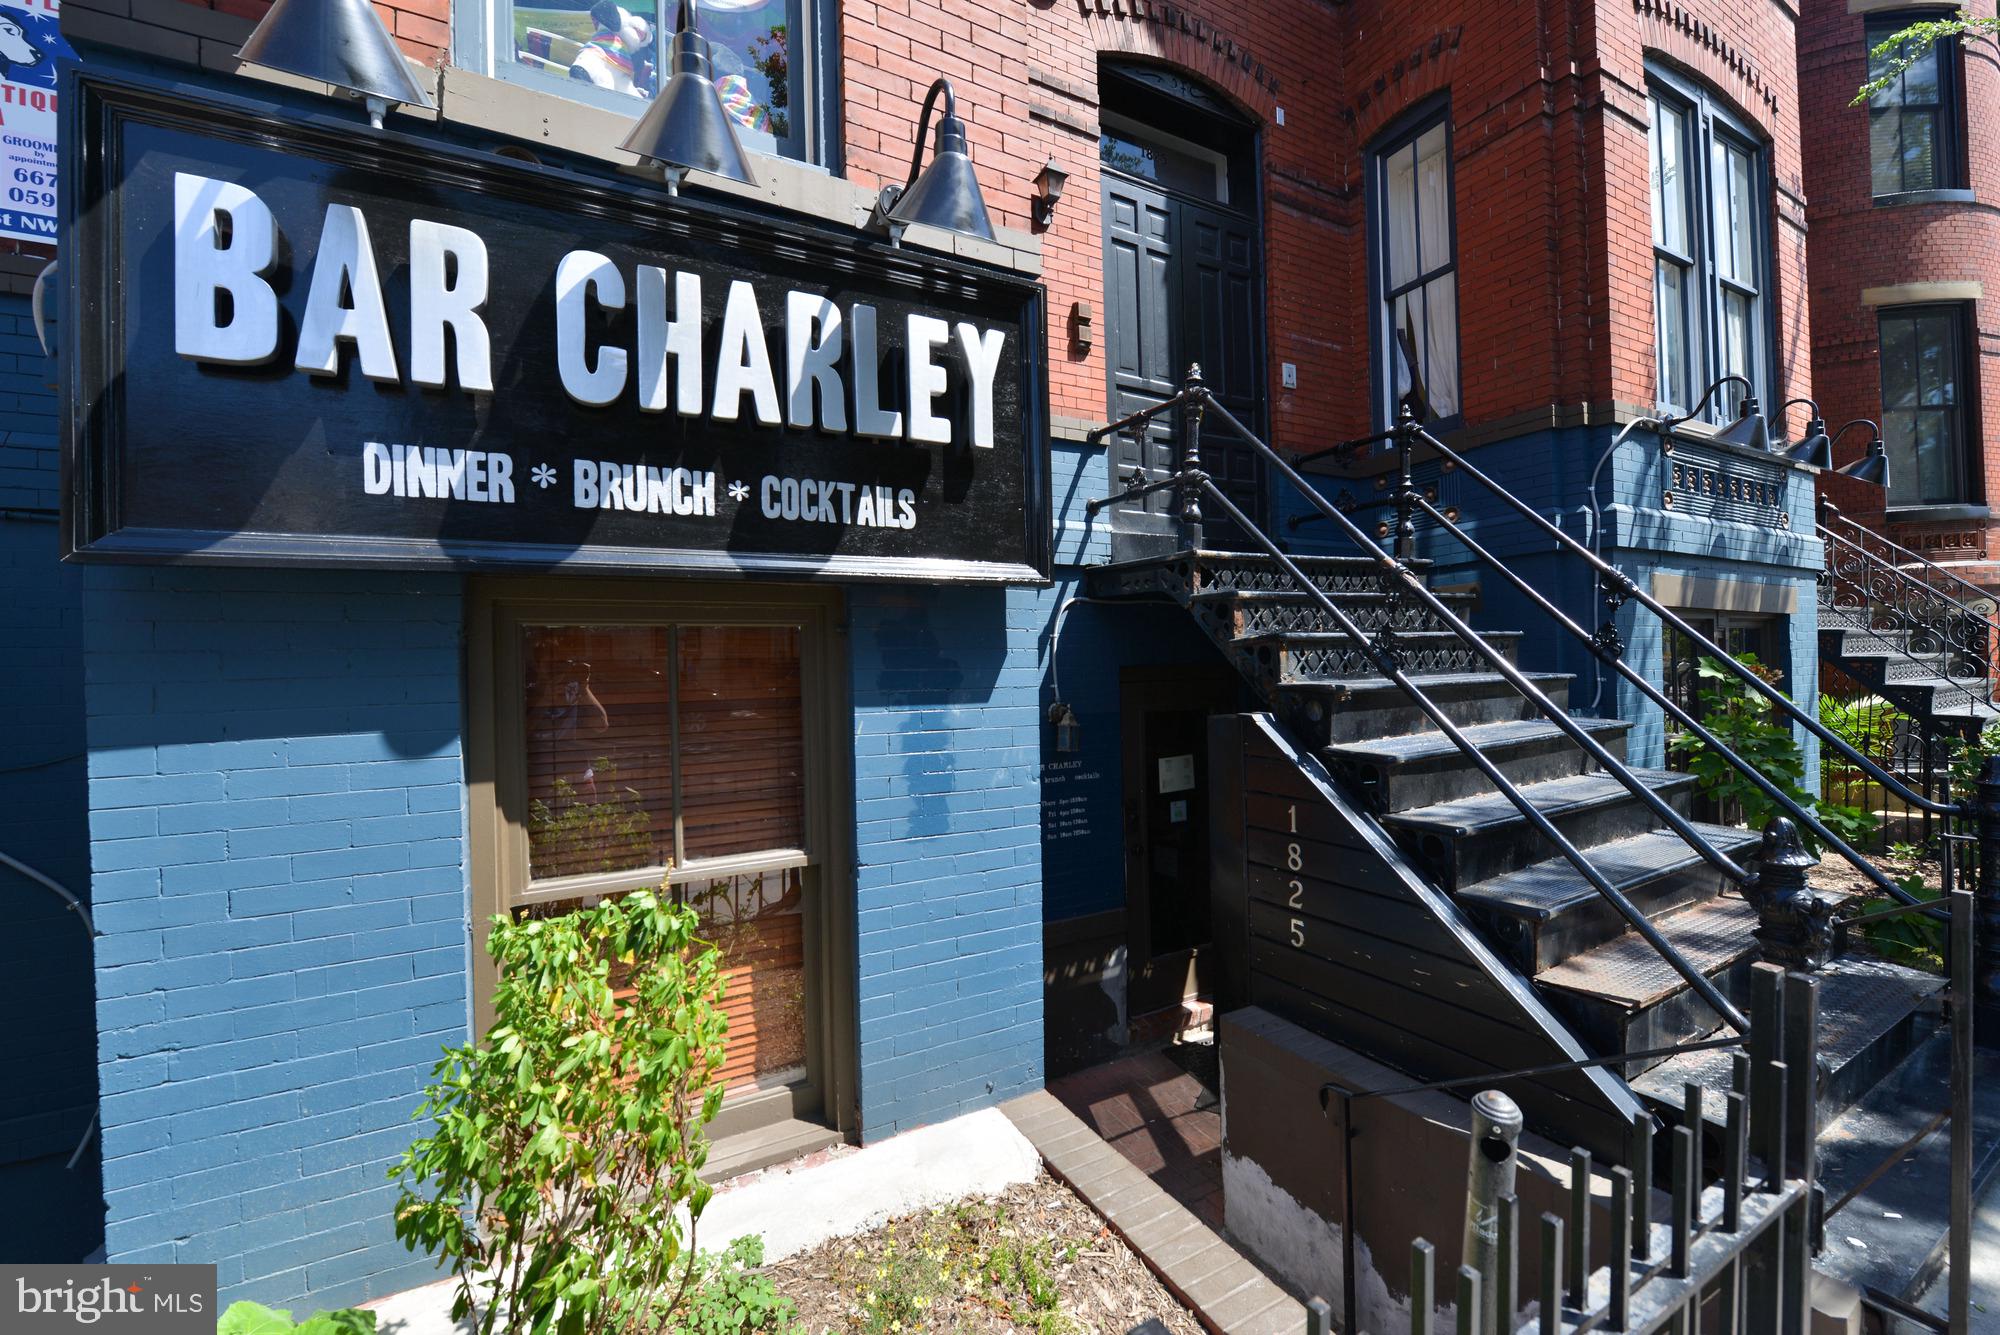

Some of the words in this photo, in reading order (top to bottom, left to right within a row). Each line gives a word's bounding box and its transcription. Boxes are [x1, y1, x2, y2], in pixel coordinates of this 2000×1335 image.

[34, 150, 45, 158] by
[13, 168, 57, 188] 667
[9, 187, 55, 207] 059
[0, 213, 12, 226] t
[21, 215, 57, 233] NW
[175, 172, 494, 394] BAR
[556, 250, 1005, 449] CHARLEY
[363, 441, 515, 503] DINNER
[574, 459, 715, 516] BRUNCH
[761, 475, 917, 530] COCKTAILS
[1048, 761, 1082, 770] CHARLEY
[1288, 805, 1305, 948] 1825
